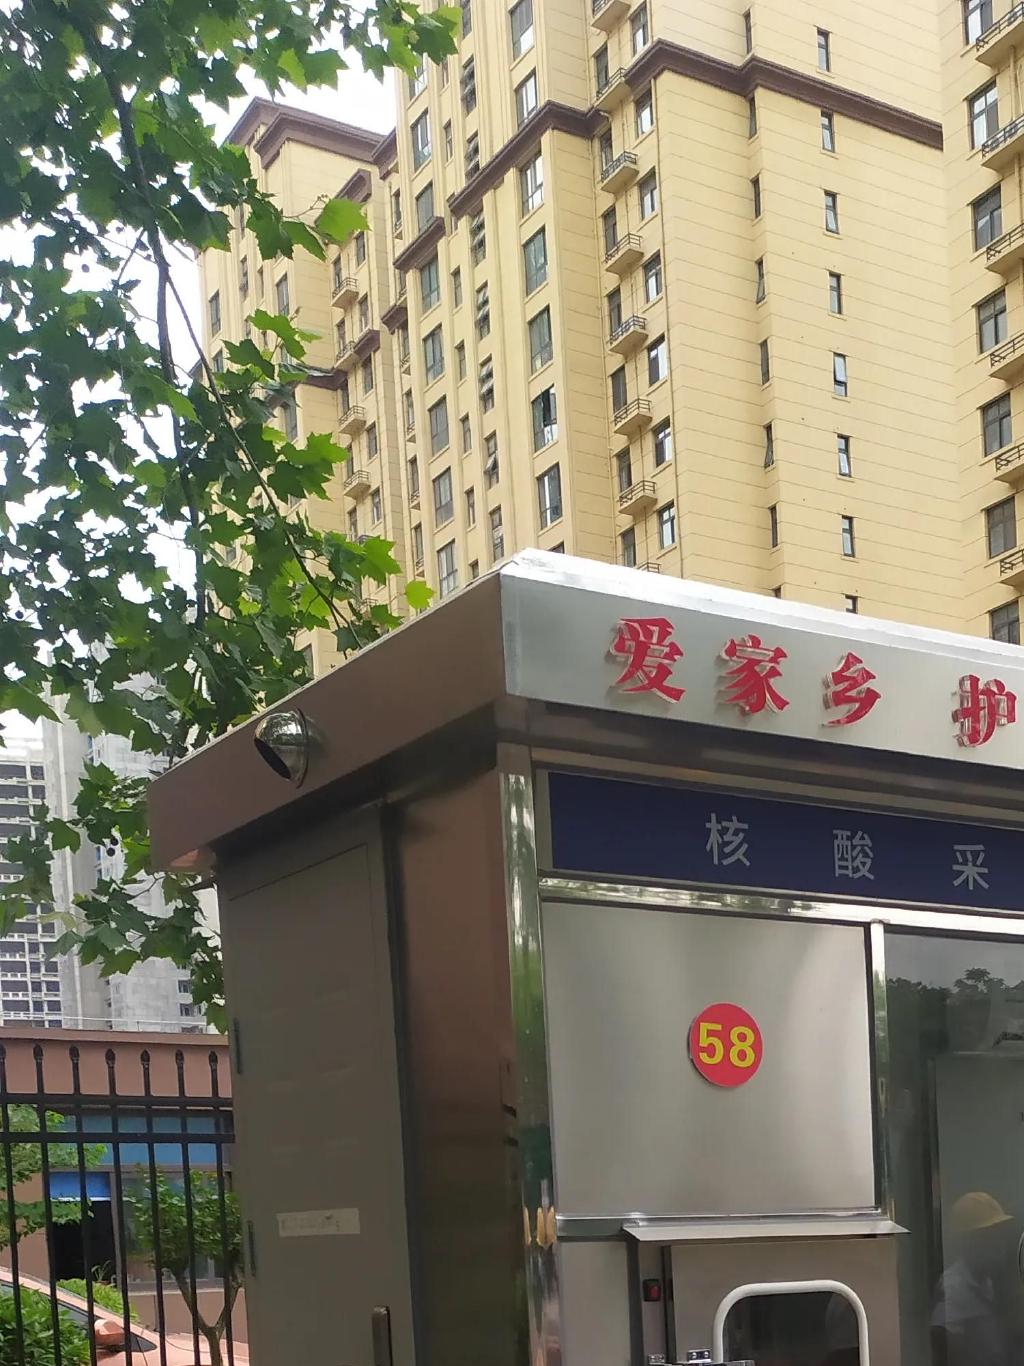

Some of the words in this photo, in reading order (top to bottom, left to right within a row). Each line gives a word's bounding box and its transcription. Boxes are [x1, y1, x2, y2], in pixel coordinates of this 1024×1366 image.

[608, 616, 881, 727] 爱家乡
[698, 1021, 756, 1069] 58
